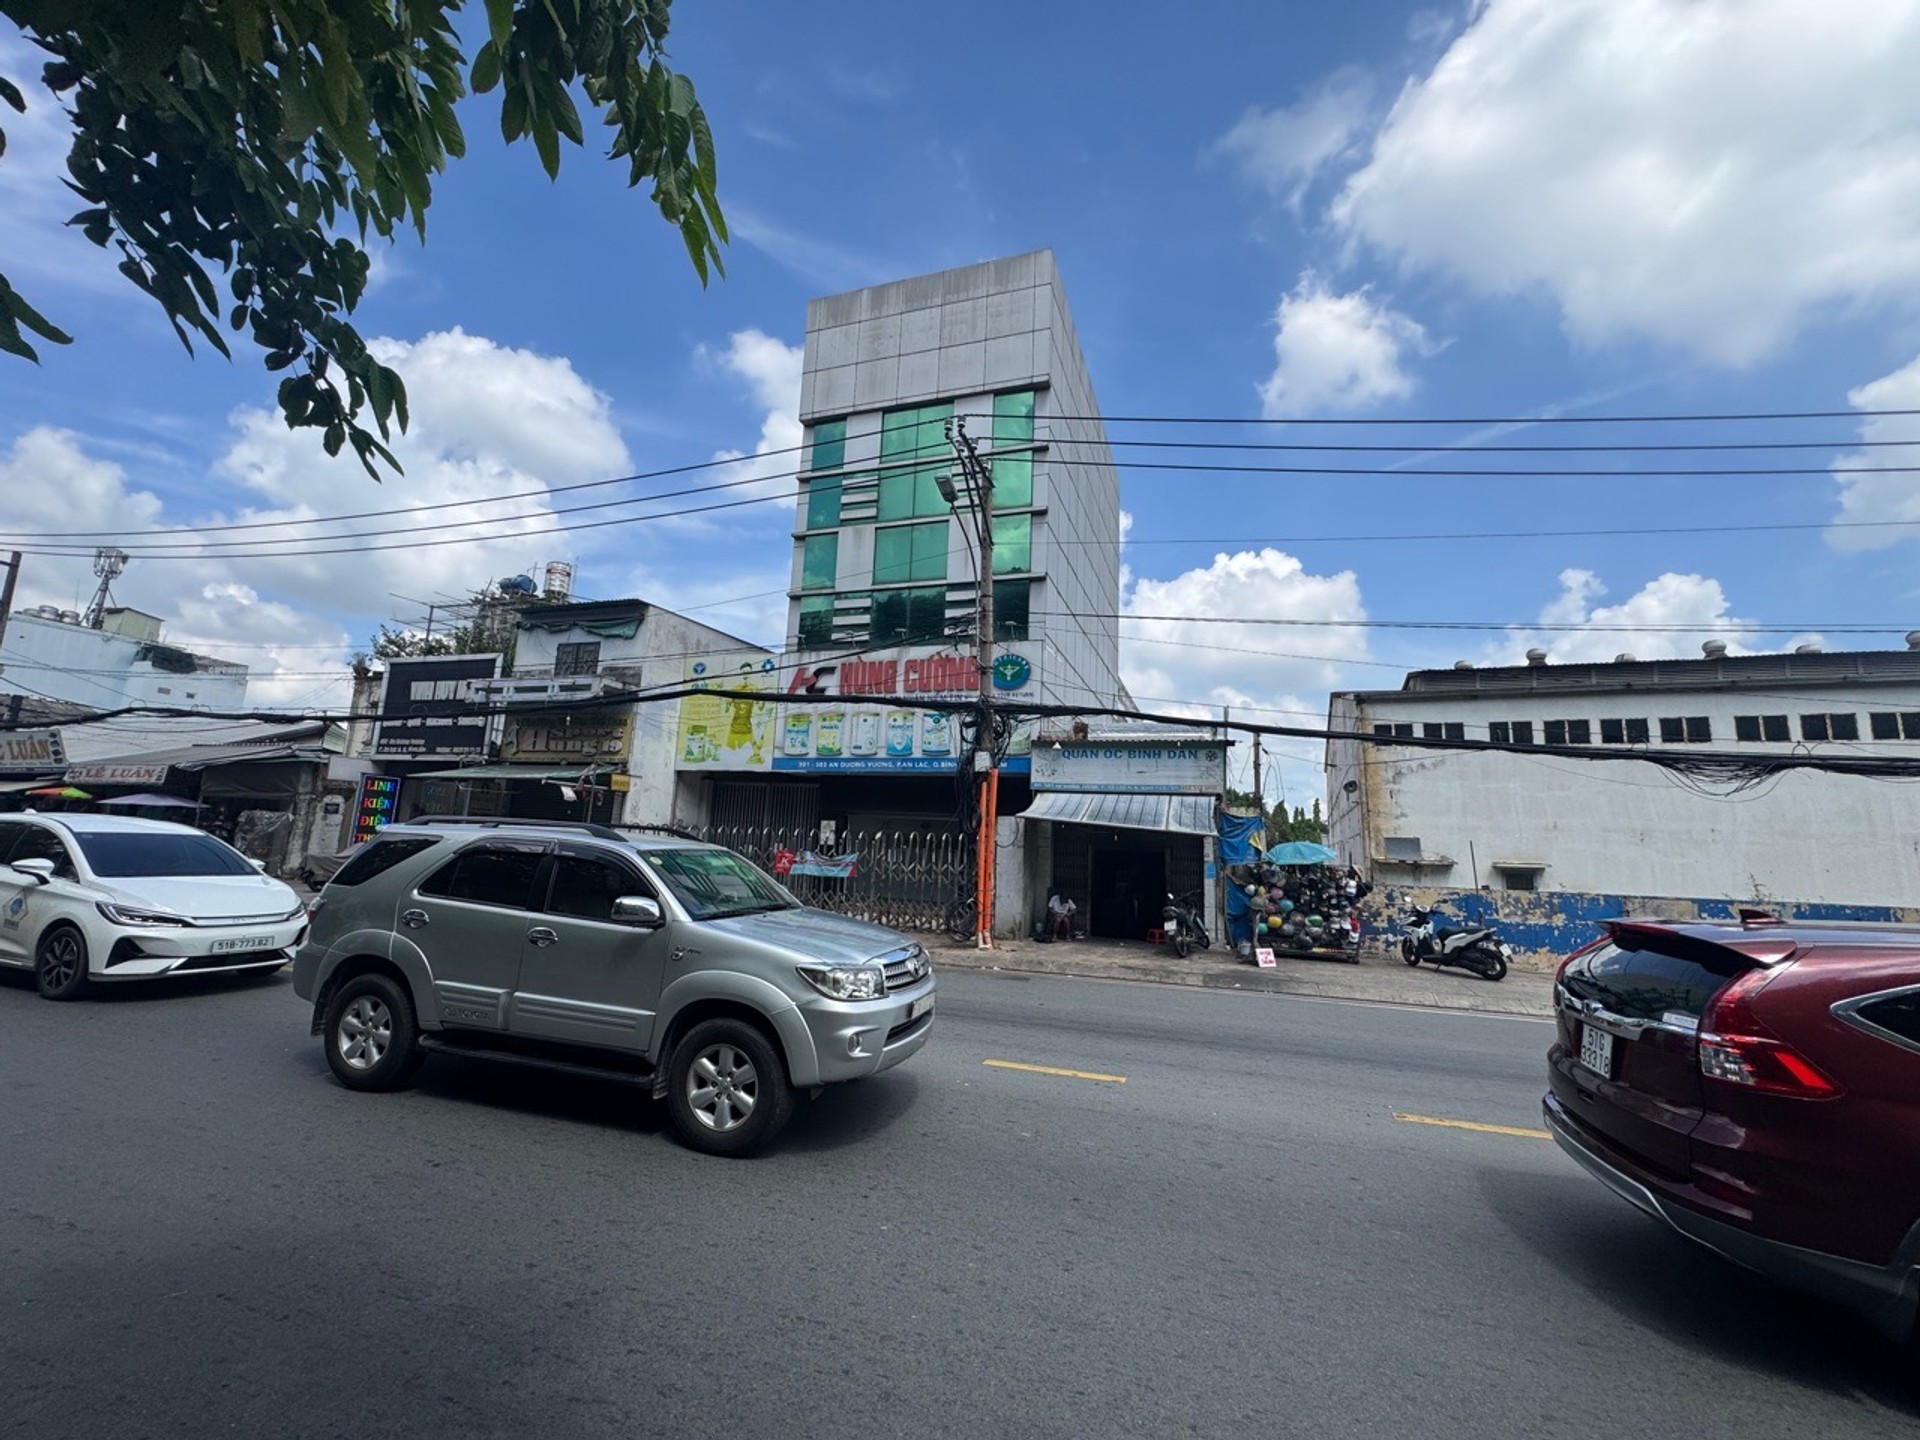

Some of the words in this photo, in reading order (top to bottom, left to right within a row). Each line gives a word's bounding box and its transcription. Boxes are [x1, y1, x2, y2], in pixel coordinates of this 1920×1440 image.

[840, 656, 897, 694] HÙNG
[367, 780, 396, 791] LINH
[363, 796, 392, 811] KIỆN
[1588, 1028, 1605, 1051] 51G
